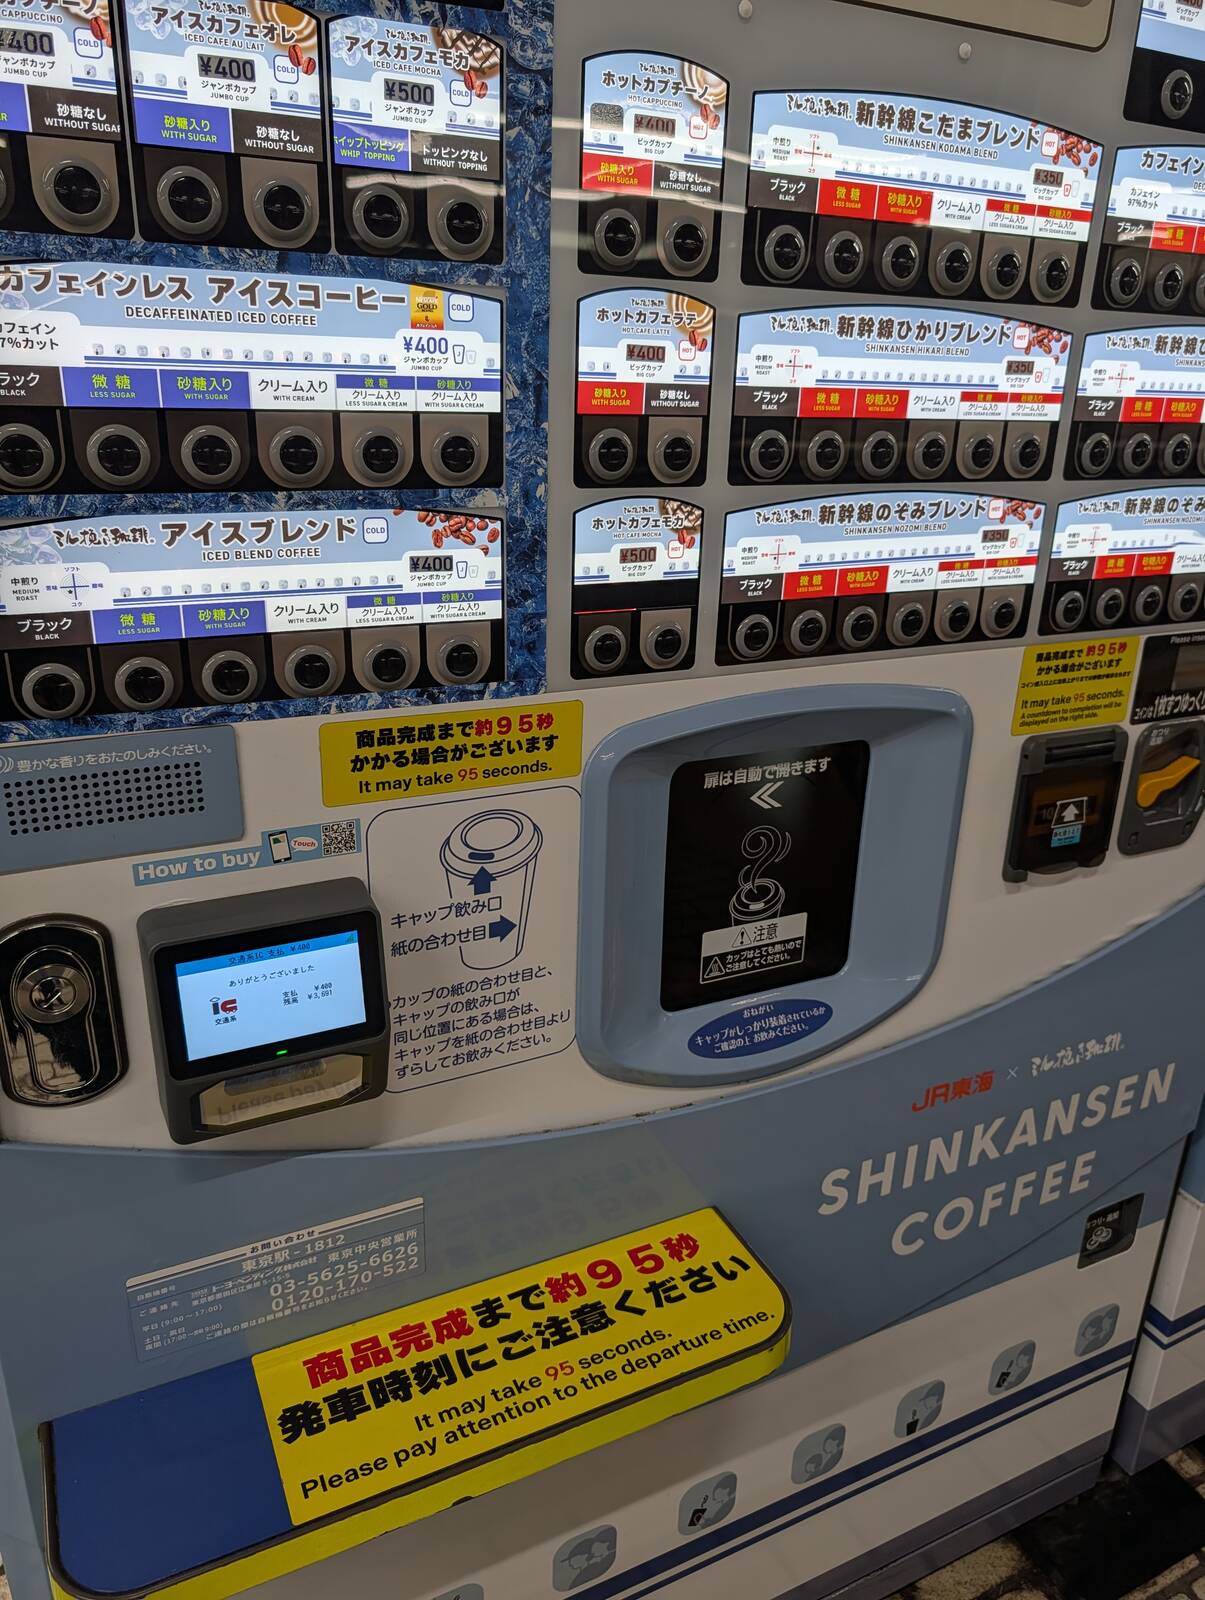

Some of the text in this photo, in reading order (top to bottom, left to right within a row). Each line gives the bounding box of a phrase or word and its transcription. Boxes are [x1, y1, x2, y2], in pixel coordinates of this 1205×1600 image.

[2, 10, 63, 23] CAPPUCCINO
[151, 7, 297, 43] アイスカフェオレ
[185, 34, 264, 51] ICED CAFE AU LAIT
[345, 36, 470, 70] アイスカフェモカ
[201, 57, 255, 80] ¥400
[277, 65, 295, 74] COLD
[374, 60, 441, 75] ICED CAFE MOCHA
[202, 80, 256, 94] ジャンボカップ
[385, 80, 433, 105] ¥500
[452, 89, 469, 98] COLD
[603, 71, 709, 100] ホットカプチーノ
[643, 98, 683, 108] CAPPUCCINO
[57, 104, 107, 120] 砂糖なし
[164, 116, 210, 131] 砂糖入り
[856, 100, 1040, 150] 新幹線こだまブレンド
[162, 130, 217, 143] WITH SUGAR
[256, 126, 300, 141] 砂糖なし
[245, 139, 314, 153] WITHOUT SUGAR
[423, 145, 488, 162] トッピングなし
[884, 135, 998, 159] SHINKANSEN KODAMA BLEND
[340, 150, 395, 161] WHIP TOPPING
[423, 158, 487, 172] WITHOUT TOPPING
[601, 162, 634, 174] 砂糖入り
[670, 171, 702, 181] 砂糖なし
[660, 181, 711, 192] WITHOUT SUGAR
[771, 179, 806, 194] ブラック
[888, 192, 922, 208] 砂糖入り
[938, 199, 981, 214] クリーム入り
[208, 276, 406, 311] アイスコーヒー
[126, 307, 316, 326] DECAFFEINATED ICED COFFEE
[452, 304, 471, 312] COLD
[598, 308, 697, 326] ホットカフェラテ
[837, 315, 1011, 345] 新幹線ひかりブレンド
[403, 337, 448, 354] ¥400
[627, 347, 664, 360] ¥400
[866, 344, 970, 356] SHINKANSEN HIKARI BLEND
[404, 356, 449, 365] ジャンボカップ
[177, 376, 232, 391] 砂糖入り
[258, 379, 328, 394] クリーム入り
[660, 390, 690, 399] 砂糖なし
[754, 391, 788, 403] ブラック
[819, 499, 986, 524] 新幹線のぞみブレンド
[593, 517, 684, 529] ホットカフェモカ
[844, 525, 892, 536] SHINKANSEN
[161, 518, 356, 547] アイスブレンド
[203, 548, 320, 562] ICED BLEND COFFEE
[622, 549, 656, 562] ¥500
[410, 557, 452, 572] ¥400
[199, 608, 250, 622] 砂糖入り
[274, 603, 339, 617] クリーム入り
[17, 618, 72, 633] ブラック
[120, 613, 156, 627] 微糖
[1037, 658, 1122, 676] かかる場合がございます
[1021, 689, 1124, 709] It may take 95 seconds.
[18, 744, 212, 773] 豊かな香りをおたのしみください。
[351, 735, 559, 773] かかる場合がございます
[359, 760, 552, 793] It may take 95 seconds.
[704, 757, 831, 789] 扉は自動で開きます
[293, 840, 316, 848] Touch
[139, 852, 260, 880] How to buy
[391, 896, 501, 928] キャップ飲み口
[390, 925, 486, 957] 紙の合わせ目
[753, 923, 779, 943] 注意
[726, 940, 802, 963] カップはとても熱いので
[726, 953, 791, 973] ご注意してください。
[229, 965, 315, 988] ありがとうございました
[282, 990, 298, 998] 支払
[393, 966, 553, 1009] カップの紙の合わせ目と、
[393, 988, 520, 1027] キャップの飲み口が
[743, 1004, 774, 1018] おねがい
[215, 1016, 237, 1025] 交通系
[394, 1002, 539, 1046] 同じ位置にある場合は、
[696, 1007, 826, 1046] キャップがしっかり装着されているか
[394, 1009, 570, 1061] キャップを紙の合わせ目より
[395, 1034, 552, 1079] ずらしてお飲みください。
[912, 1071, 995, 1113] JR東海
[817, 1063, 1176, 1216] SHINKANSEN
[891, 1151, 1097, 1257] COFFEE
[250, 1230, 316, 1253] お問い合わせ
[328, 1229, 418, 1264] 東京中央営業所
[270, 1244, 418, 1297] 03-5625-6626
[272, 1257, 419, 1312] 0120-170-522
[277, 1253, 751, 1445] 発車時刻にご注意ください
[415, 1327, 672, 1432] It may take 95 seconds.
[301, 1307, 775, 1500] Please pay attention to the departure time.
